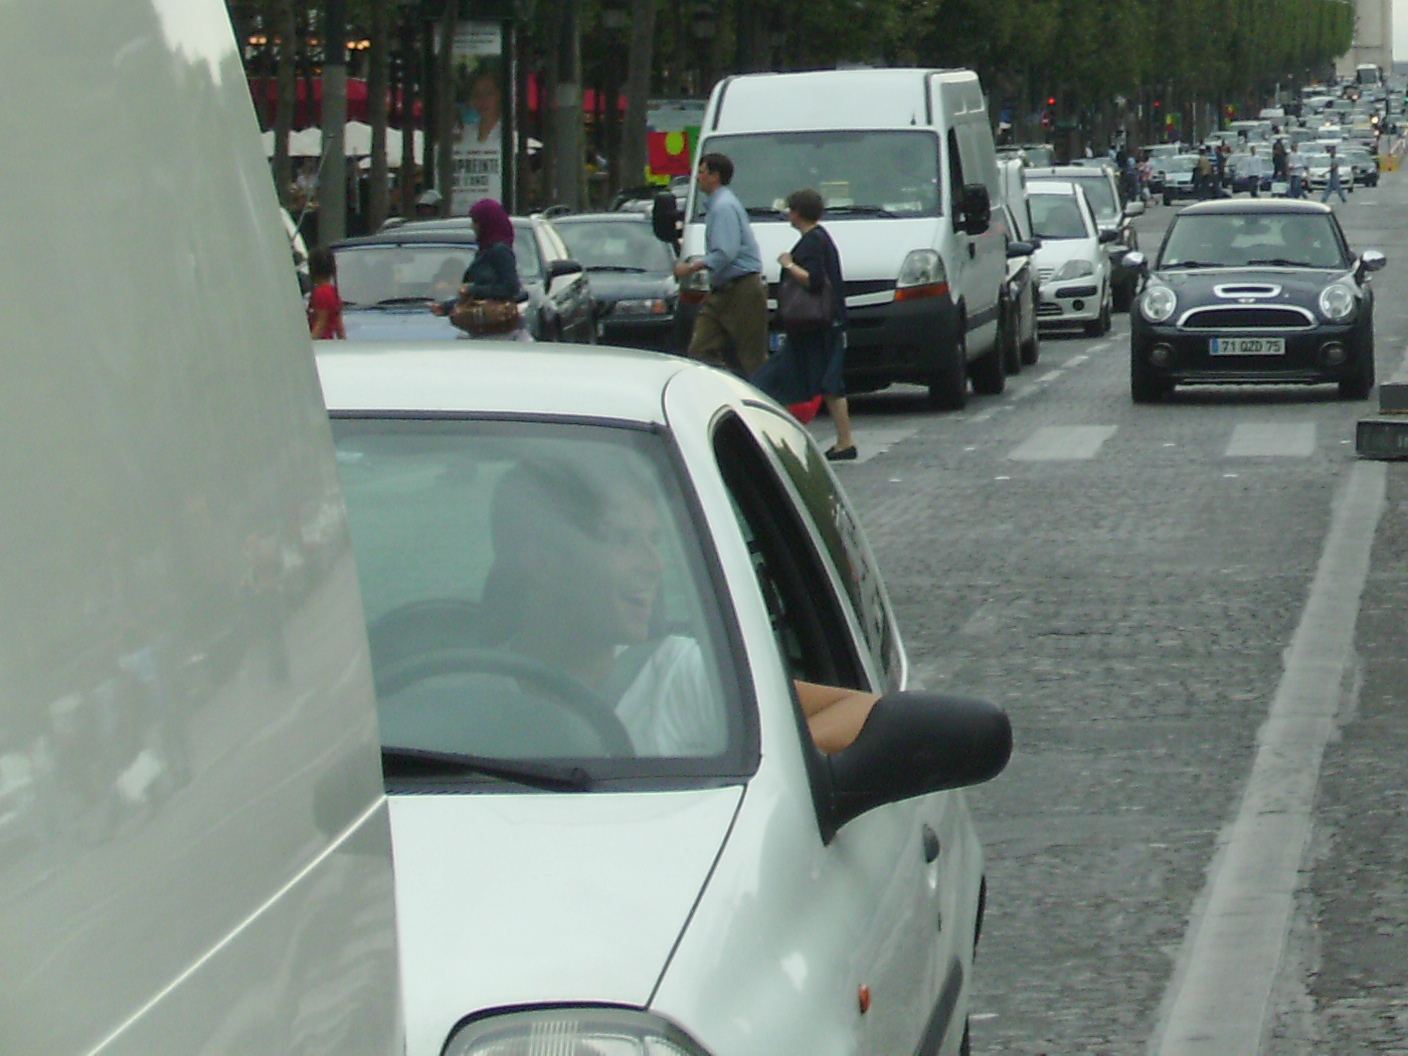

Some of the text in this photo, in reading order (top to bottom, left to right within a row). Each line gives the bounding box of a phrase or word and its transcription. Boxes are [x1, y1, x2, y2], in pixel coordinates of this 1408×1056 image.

[1222, 340, 1281, 353] 71 QZD 75
